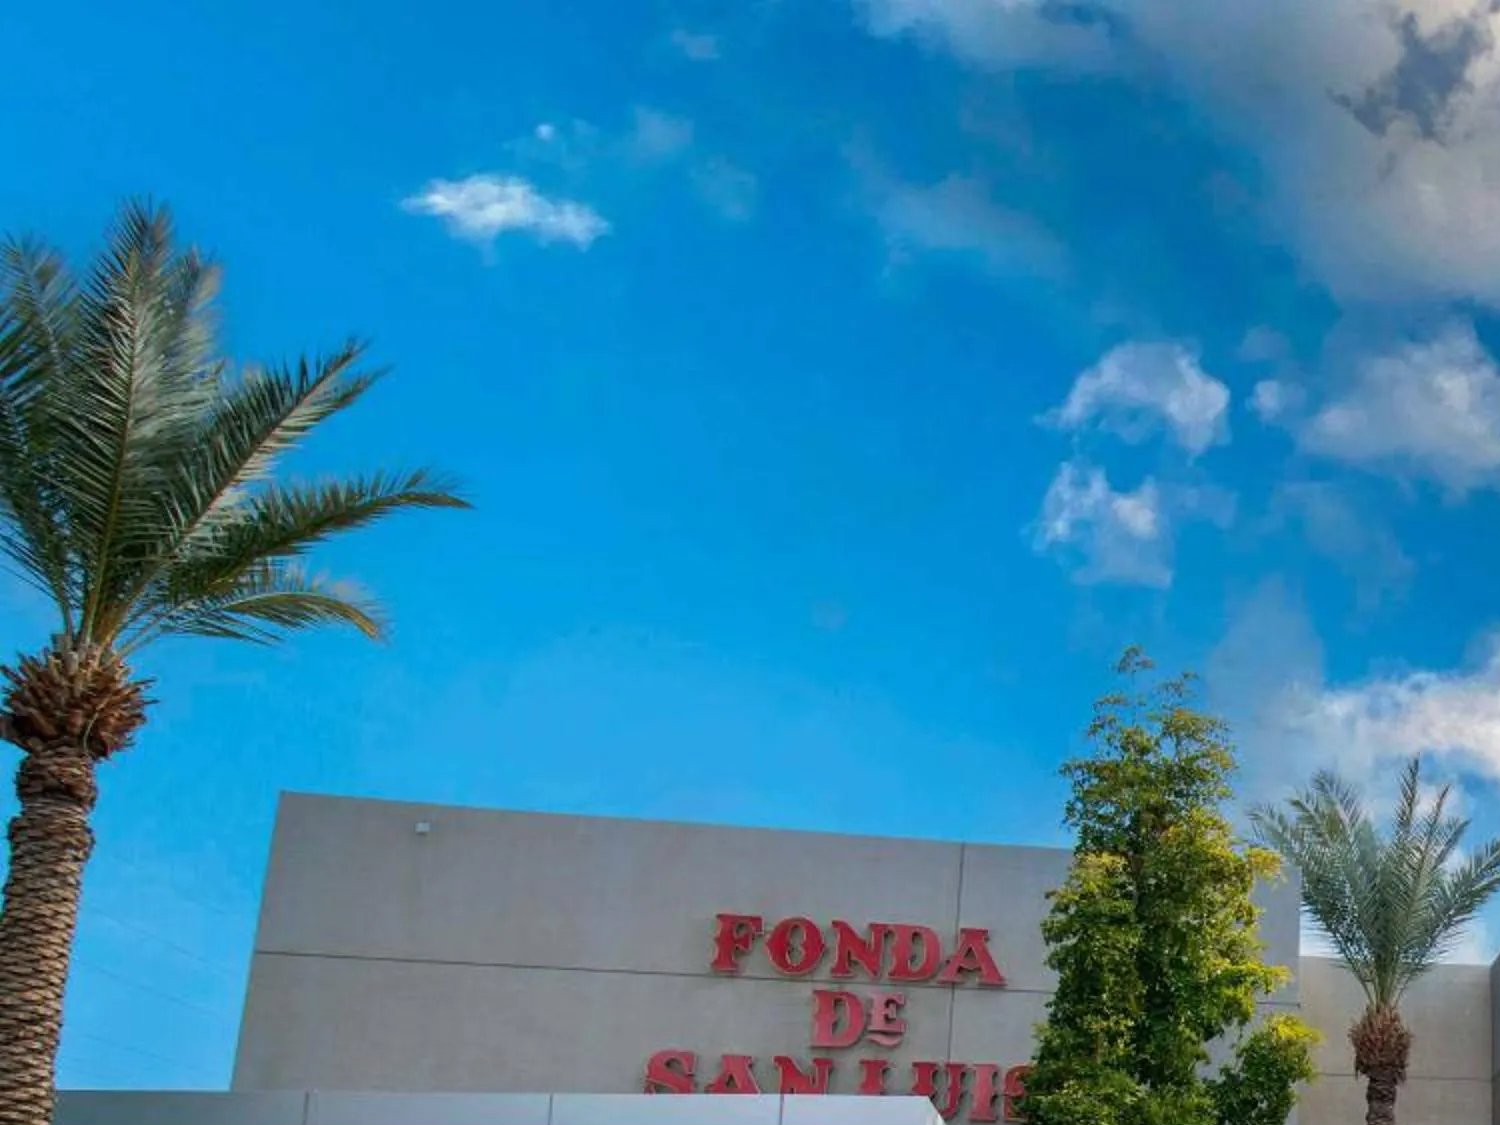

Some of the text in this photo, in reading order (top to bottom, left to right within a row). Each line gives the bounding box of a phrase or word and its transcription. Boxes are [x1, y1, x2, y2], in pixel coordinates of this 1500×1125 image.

[711, 913, 1008, 986] FONDA
[810, 989, 907, 1048] DE
[643, 1050, 834, 1095] SAN
